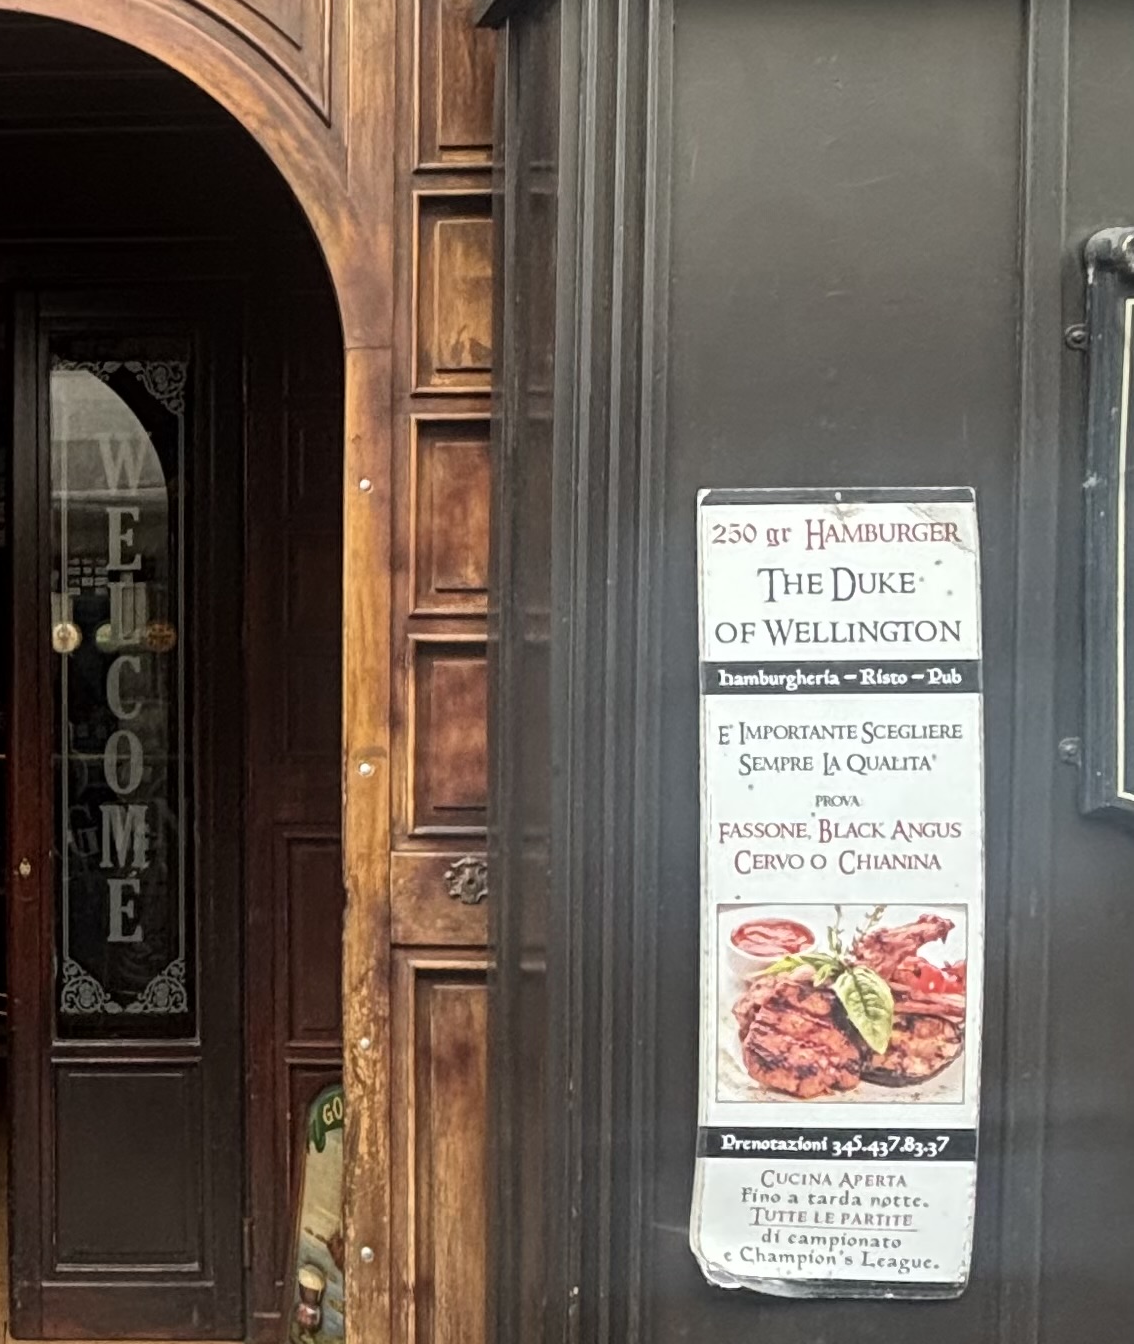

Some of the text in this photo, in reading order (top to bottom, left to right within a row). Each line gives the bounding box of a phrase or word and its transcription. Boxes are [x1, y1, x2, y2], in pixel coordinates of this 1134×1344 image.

[711, 519, 962, 550] 250 gr HAMBURGER
[757, 567, 916, 603] THE DUKE
[715, 619, 962, 646] OF WELLINGTON
[96, 431, 152, 942] WELCOME
[718, 669, 840, 691] hamburgheria
[859, 668, 908, 685] Risto
[926, 667, 962, 685] Pub
[738, 721, 858, 745] IMPORTANTE
[861, 721, 963, 744] SCEGLIERE
[738, 752, 937, 776] SEMPRE LA QUALITA'
[815, 795, 860, 807] PROVA
[718, 819, 962, 844] FASSONE, BLACK ANGUS
[734, 850, 805, 875] CERVO
[838, 850, 942, 875] CHIANINA
[720, 1134, 950, 1157] Prenotazioni 345.437.83.37
[760, 1169, 907, 1189] CUCINA APERTA
[741, 1186, 930, 1208] Fino a tarda notte.
[750, 1207, 914, 1226] TUTTE LE PARTITE
[761, 1228, 902, 1252] di campionato
[723, 1247, 940, 1274] e Champion's League.
